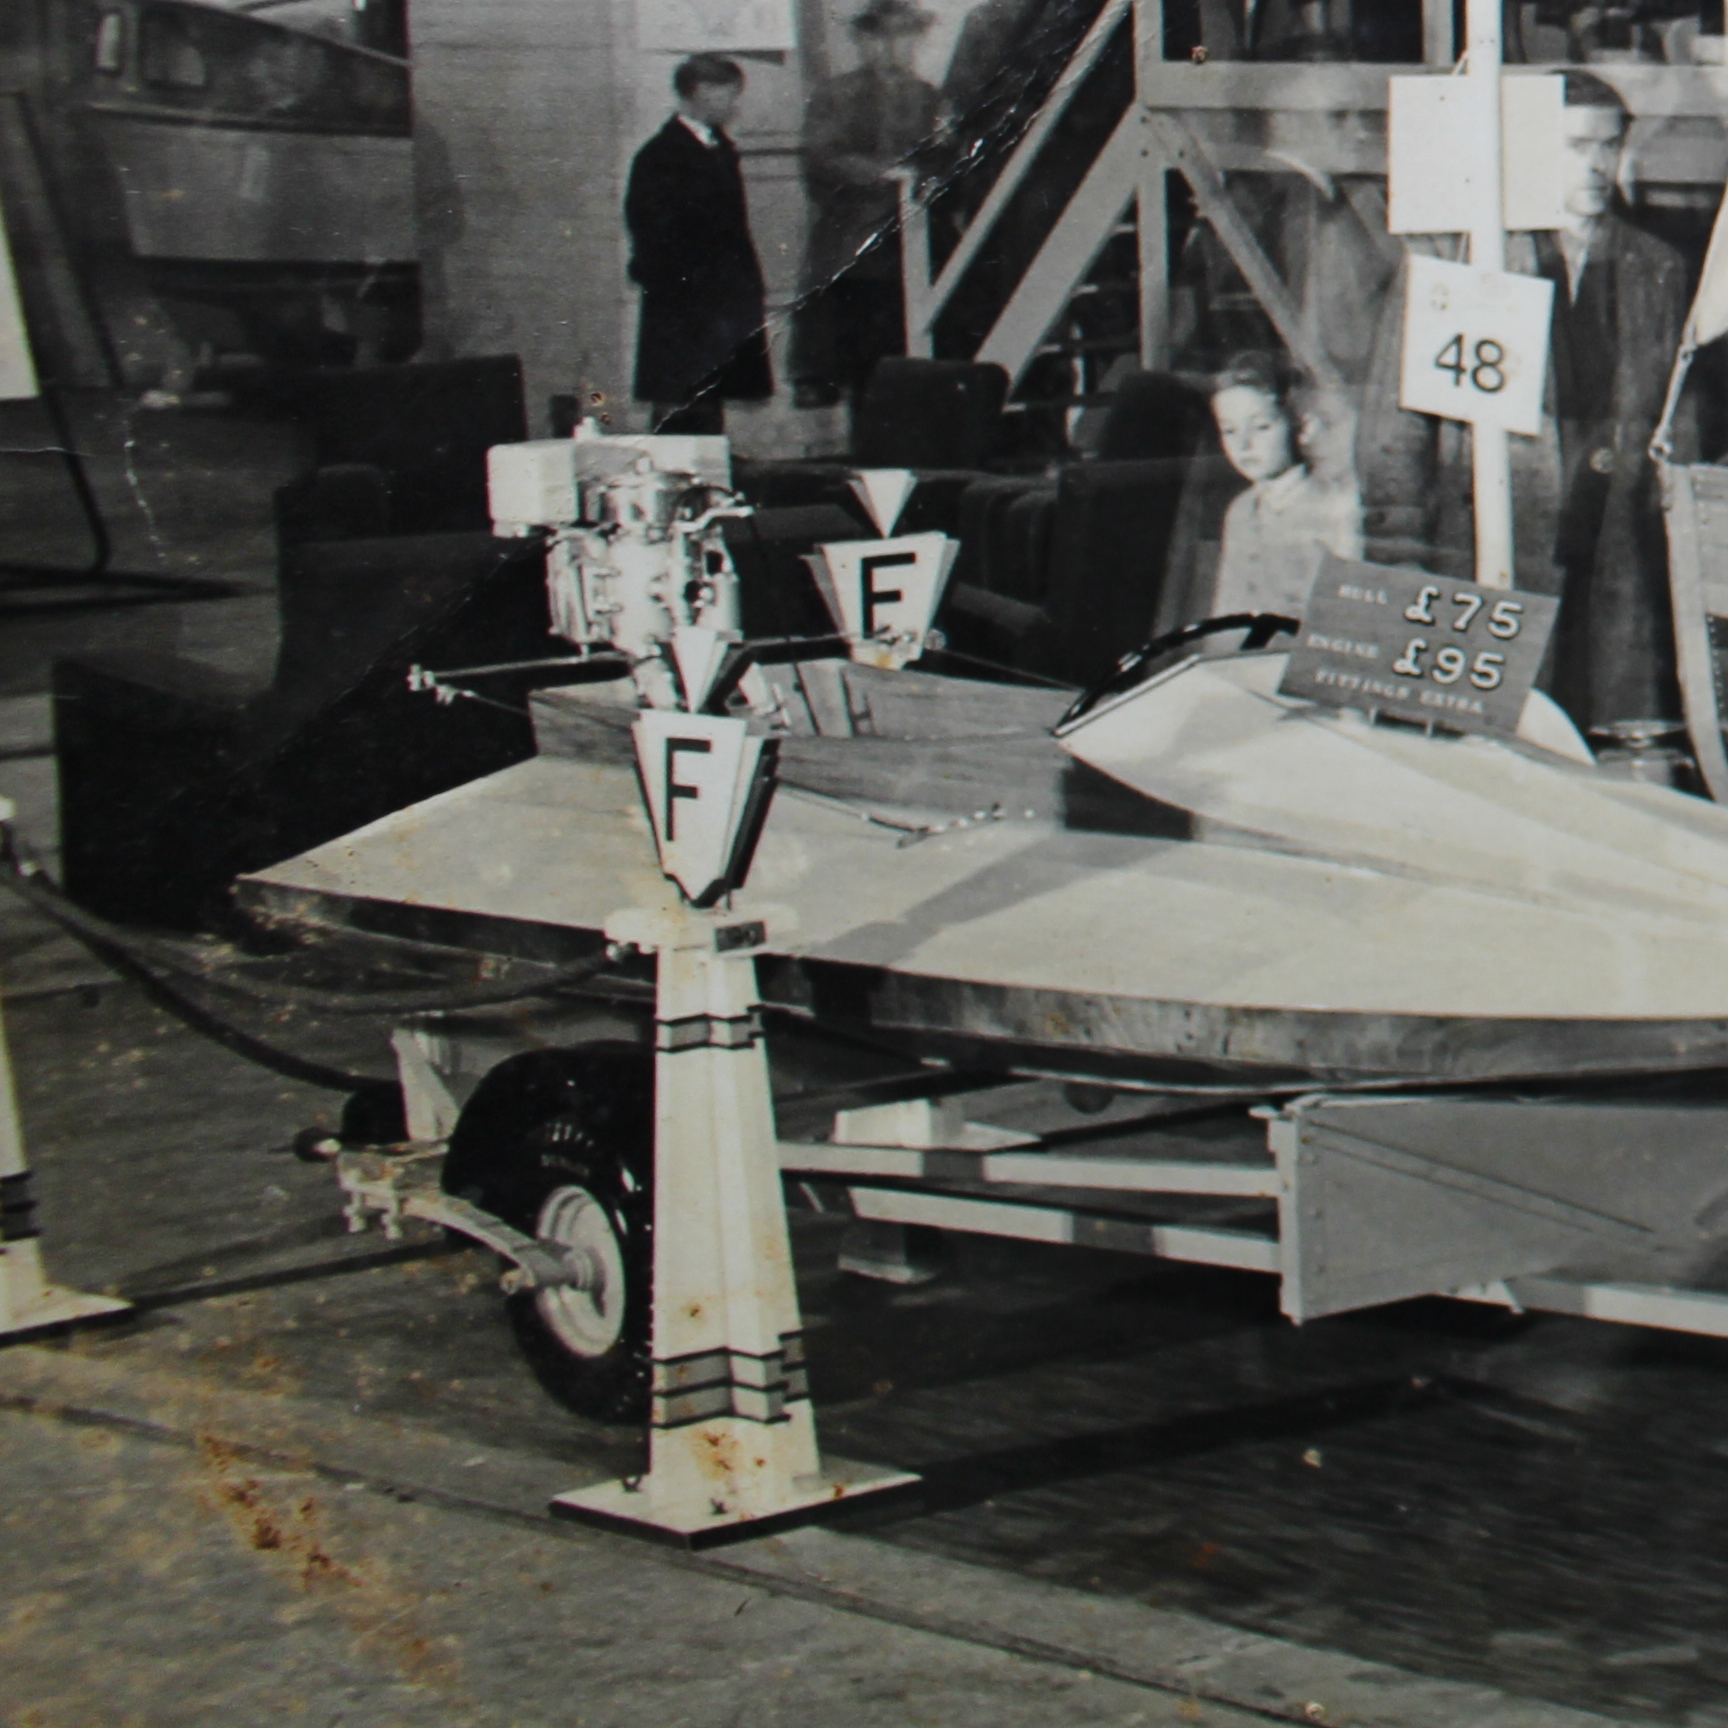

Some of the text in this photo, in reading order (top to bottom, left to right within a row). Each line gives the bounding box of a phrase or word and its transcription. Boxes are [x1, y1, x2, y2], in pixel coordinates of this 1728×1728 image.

[1433, 332, 1508, 394] 48
[860, 552, 918, 638] F
[1338, 583, 1525, 641] HULL £75
[1305, 634, 1507, 692] ENGINE £95
[1312, 669, 1486, 715] FITTINGS EXTRA
[665, 737, 711, 842] F
